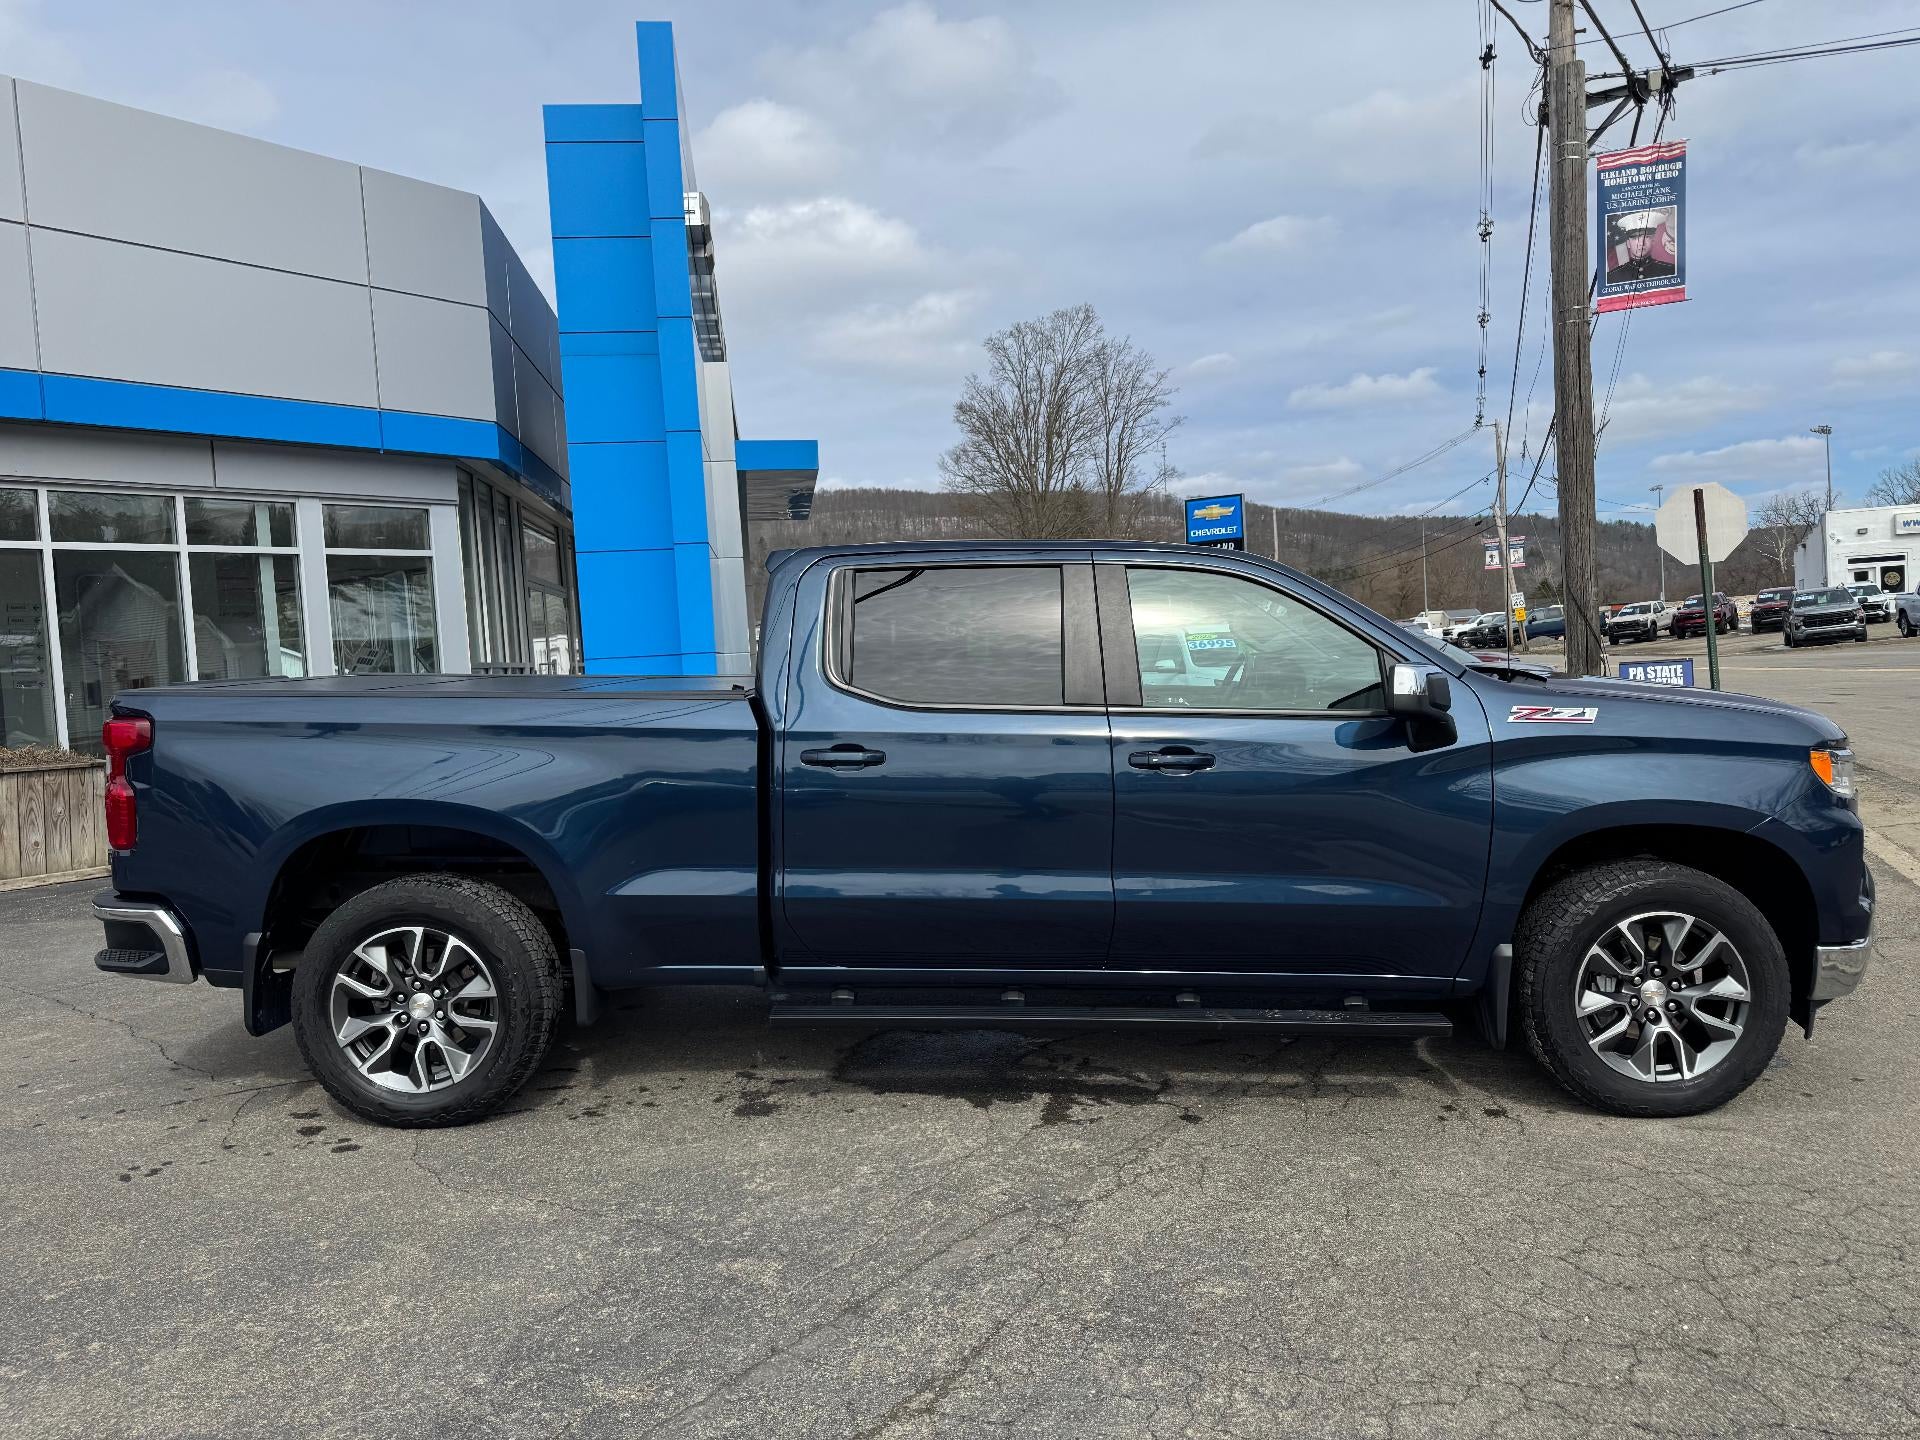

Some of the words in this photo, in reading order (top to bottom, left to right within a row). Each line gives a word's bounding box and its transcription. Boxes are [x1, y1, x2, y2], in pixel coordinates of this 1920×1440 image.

[1600, 168, 1638, 180] ELKLAND
[1640, 161, 1683, 174] BOROUGH
[1604, 173, 1653, 186] HOMETOWN
[1654, 170, 1679, 180] HERO
[1611, 189, 1646, 200] MICHAEL
[1621, 198, 1650, 208] MARINE
[1651, 194, 1676, 203] CORPS
[1190, 526, 1238, 537] CHEVROLET
[1188, 639, 1234, 650] 36995
[1628, 666, 1645, 680] PA
[1646, 664, 1684, 679] STATE
[1507, 705, 1599, 724] Z71
